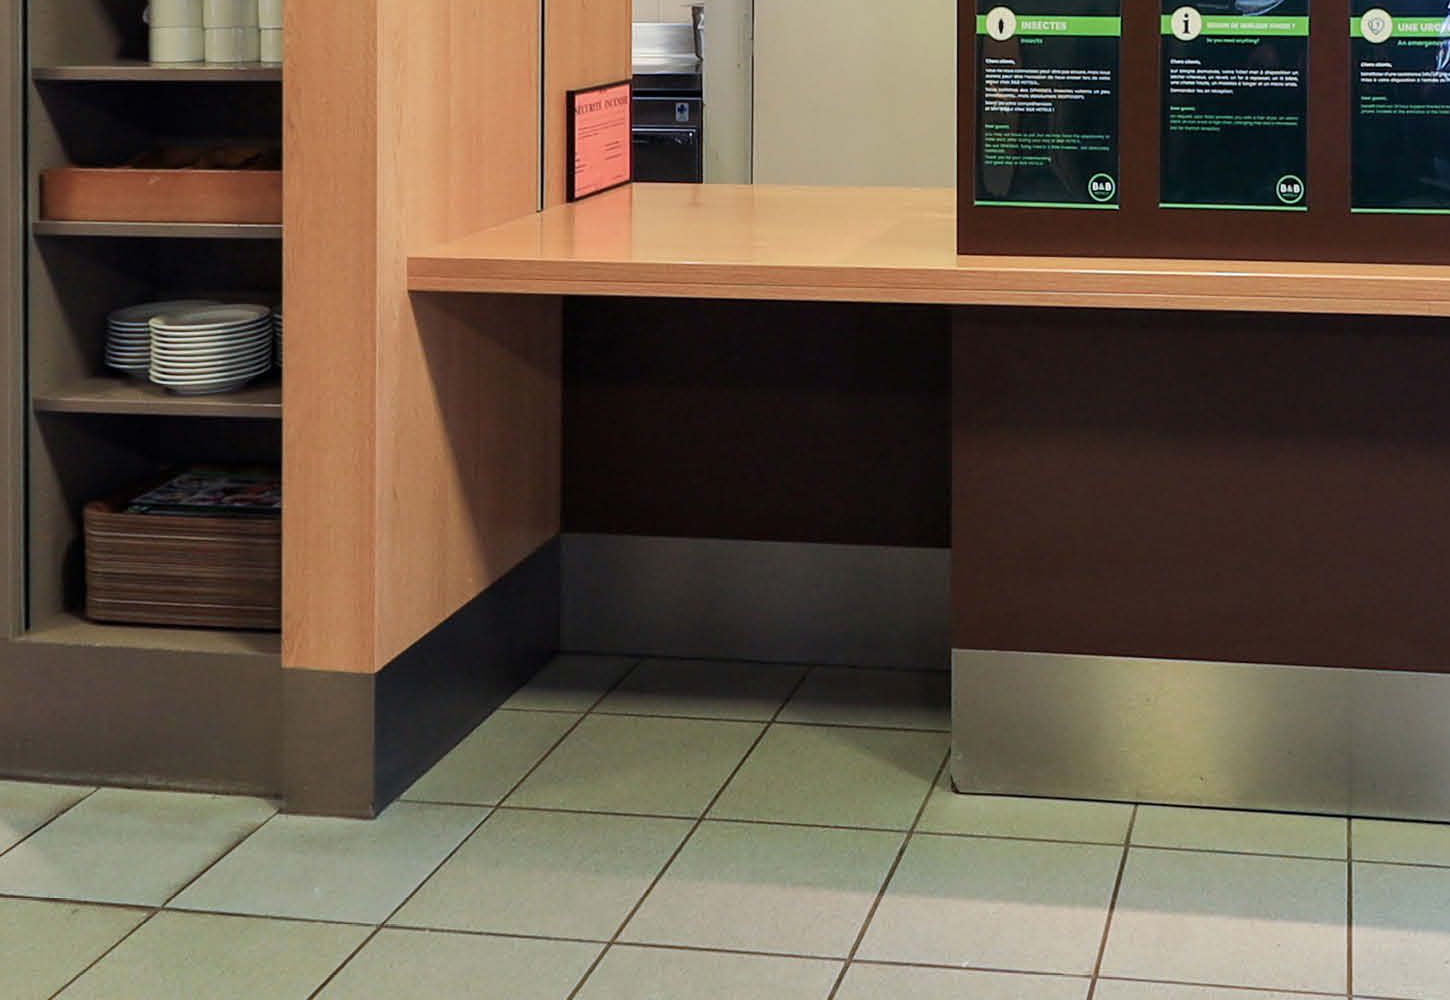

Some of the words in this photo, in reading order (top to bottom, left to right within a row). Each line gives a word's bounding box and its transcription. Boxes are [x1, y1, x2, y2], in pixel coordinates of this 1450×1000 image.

[1021, 21, 1068, 31] INSECTES
[1398, 23, 1418, 32] UNE
[1280, 184, 1300, 193] B&B
